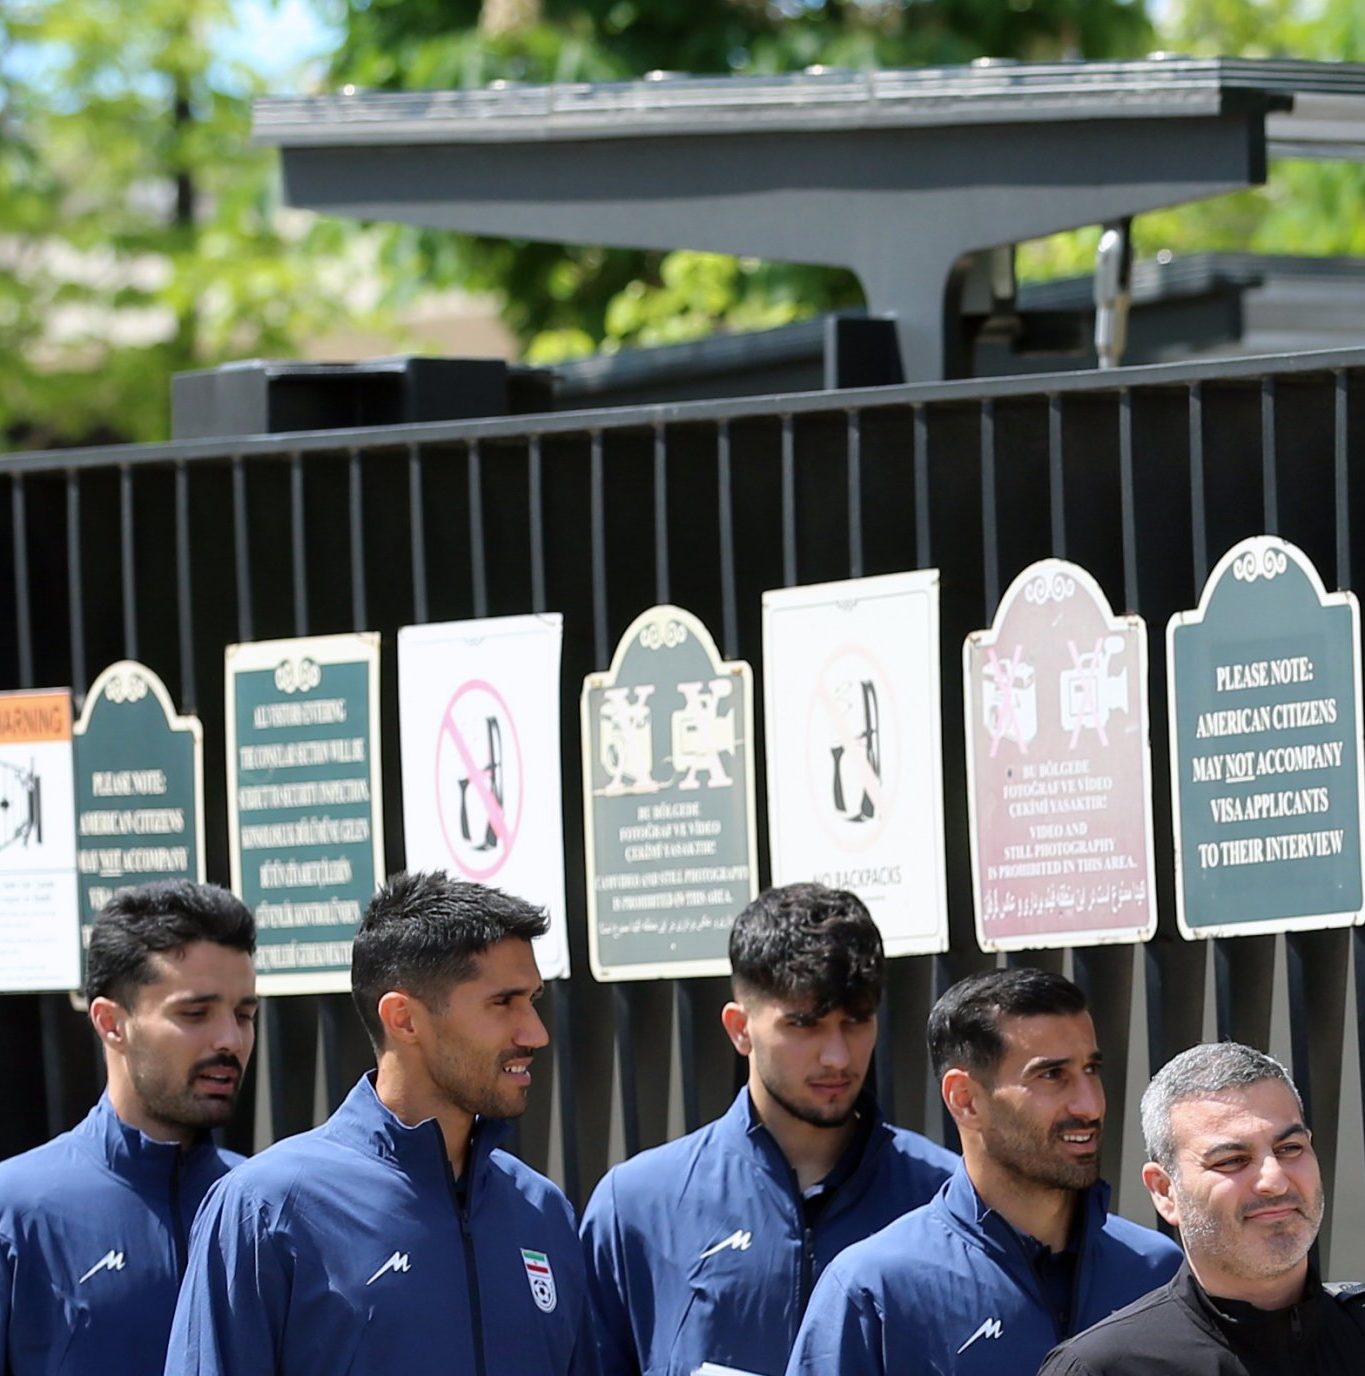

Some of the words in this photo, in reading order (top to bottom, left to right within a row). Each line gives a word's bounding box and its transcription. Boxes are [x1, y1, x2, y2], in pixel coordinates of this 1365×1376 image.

[1216, 661, 1269, 692] PLEASE
[1270, 656, 1314, 685] NOTE:
[1196, 706, 1271, 738] AMERICAN
[1272, 698, 1337, 730] CITIZENS
[1192, 754, 1224, 782] MAY
[1225, 752, 1256, 783] NOT
[1256, 742, 1343, 775] ACCOMPANY
[1211, 796, 1243, 823] VISA
[1243, 787, 1329, 820] APPLICANTS
[1004, 845, 1034, 861] STILL
[1035, 838, 1115, 858] PHOTOGRAPHY
[1198, 843, 1219, 868] TO
[1220, 838, 1264, 866] THEIR
[1265, 829, 1344, 862] INTERVIEW
[998, 861, 1062, 880] PROHIBITED
[1063, 859, 1076, 874] IN
[1077, 857, 1103, 873] THIS
